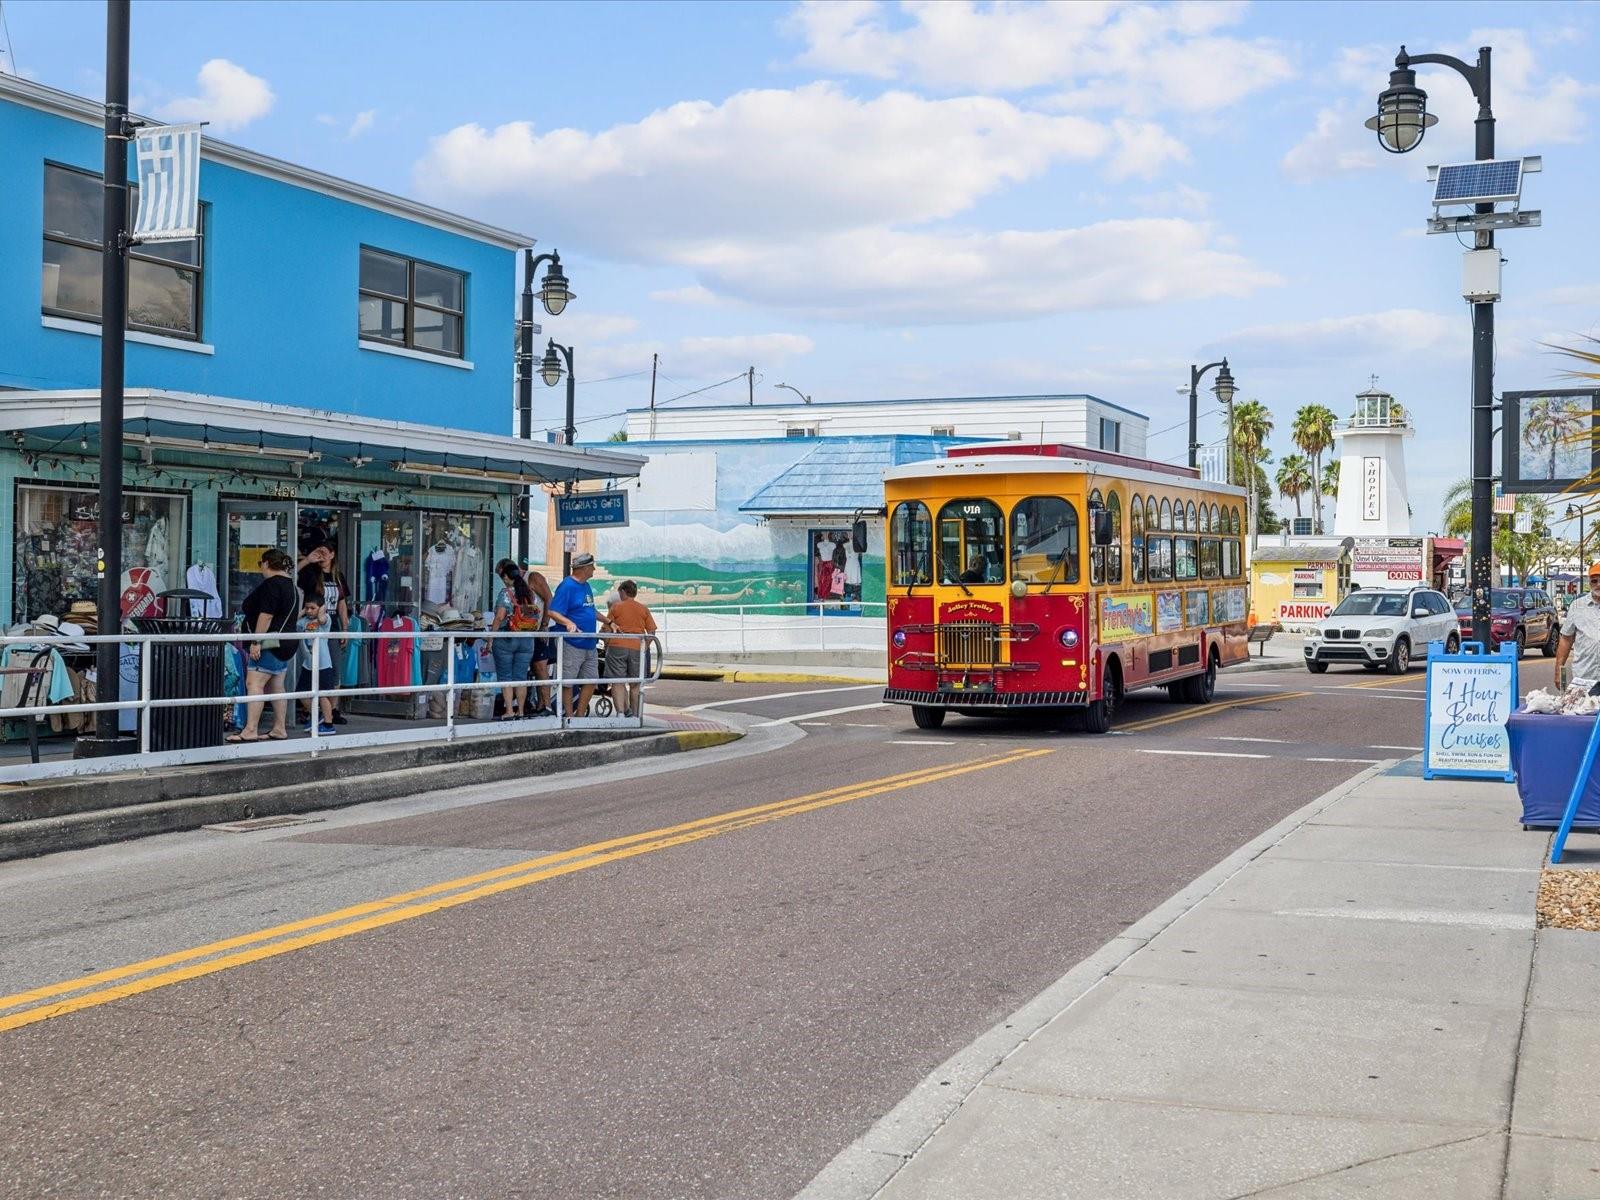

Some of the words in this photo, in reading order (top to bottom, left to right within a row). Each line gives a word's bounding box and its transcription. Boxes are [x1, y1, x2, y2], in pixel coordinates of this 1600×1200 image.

[1368, 461, 1376, 517] SHOPPES
[561, 500, 597, 510] GLORIA'S
[600, 498, 621, 509] GFTS
[963, 505, 981, 514] VIA
[1308, 562, 1336, 570] PARKING
[1389, 572, 1419, 580] COINS
[130, 592, 154, 617] GUARD
[968, 602, 994, 613] Trolley
[1102, 601, 1143, 631] Frenchy's
[1442, 681, 1454, 700] 4
[1460, 677, 1502, 706] Hour
[1446, 701, 1498, 728] Beach
[1442, 723, 1502, 749] Cruises
